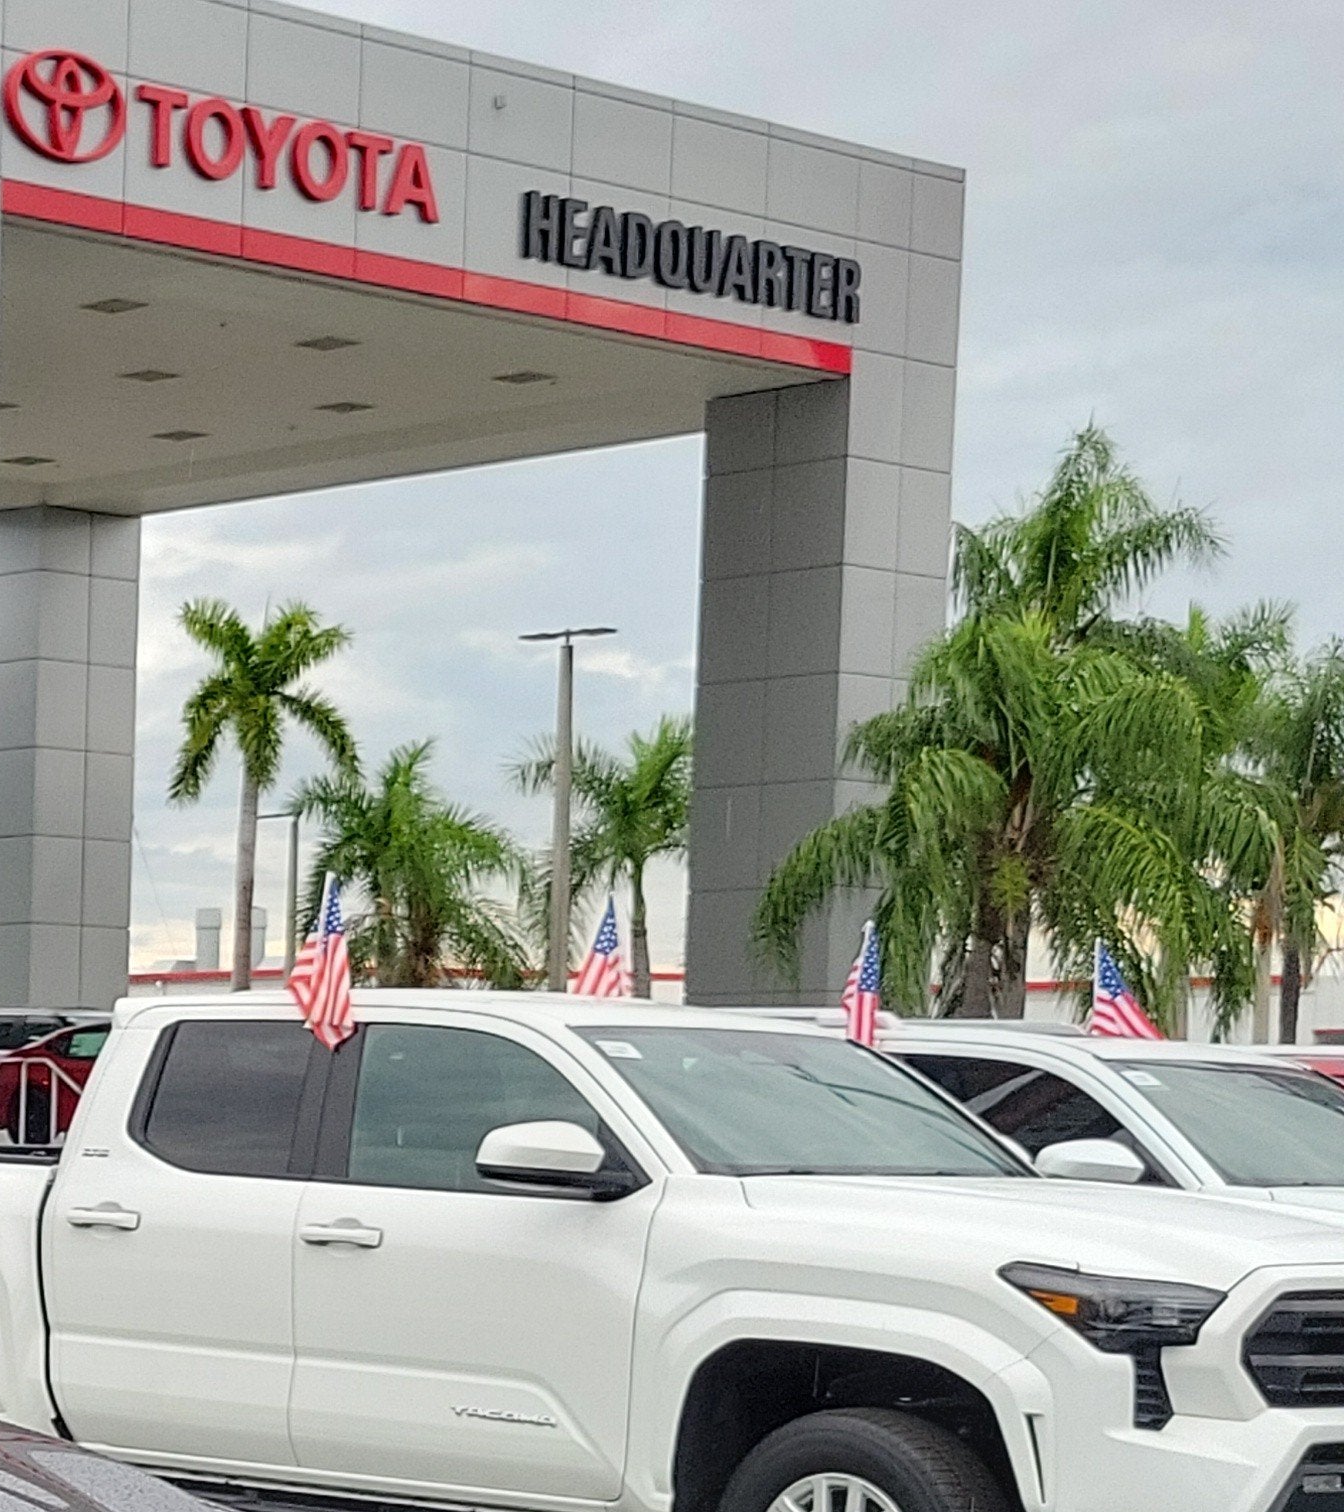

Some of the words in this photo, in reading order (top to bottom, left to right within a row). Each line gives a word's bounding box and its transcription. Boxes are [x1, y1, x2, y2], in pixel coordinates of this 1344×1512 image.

[138, 84, 439, 224] TOYOTA
[522, 190, 861, 324] HEADQUARTER
[450, 1404, 558, 1428] TACOMA
